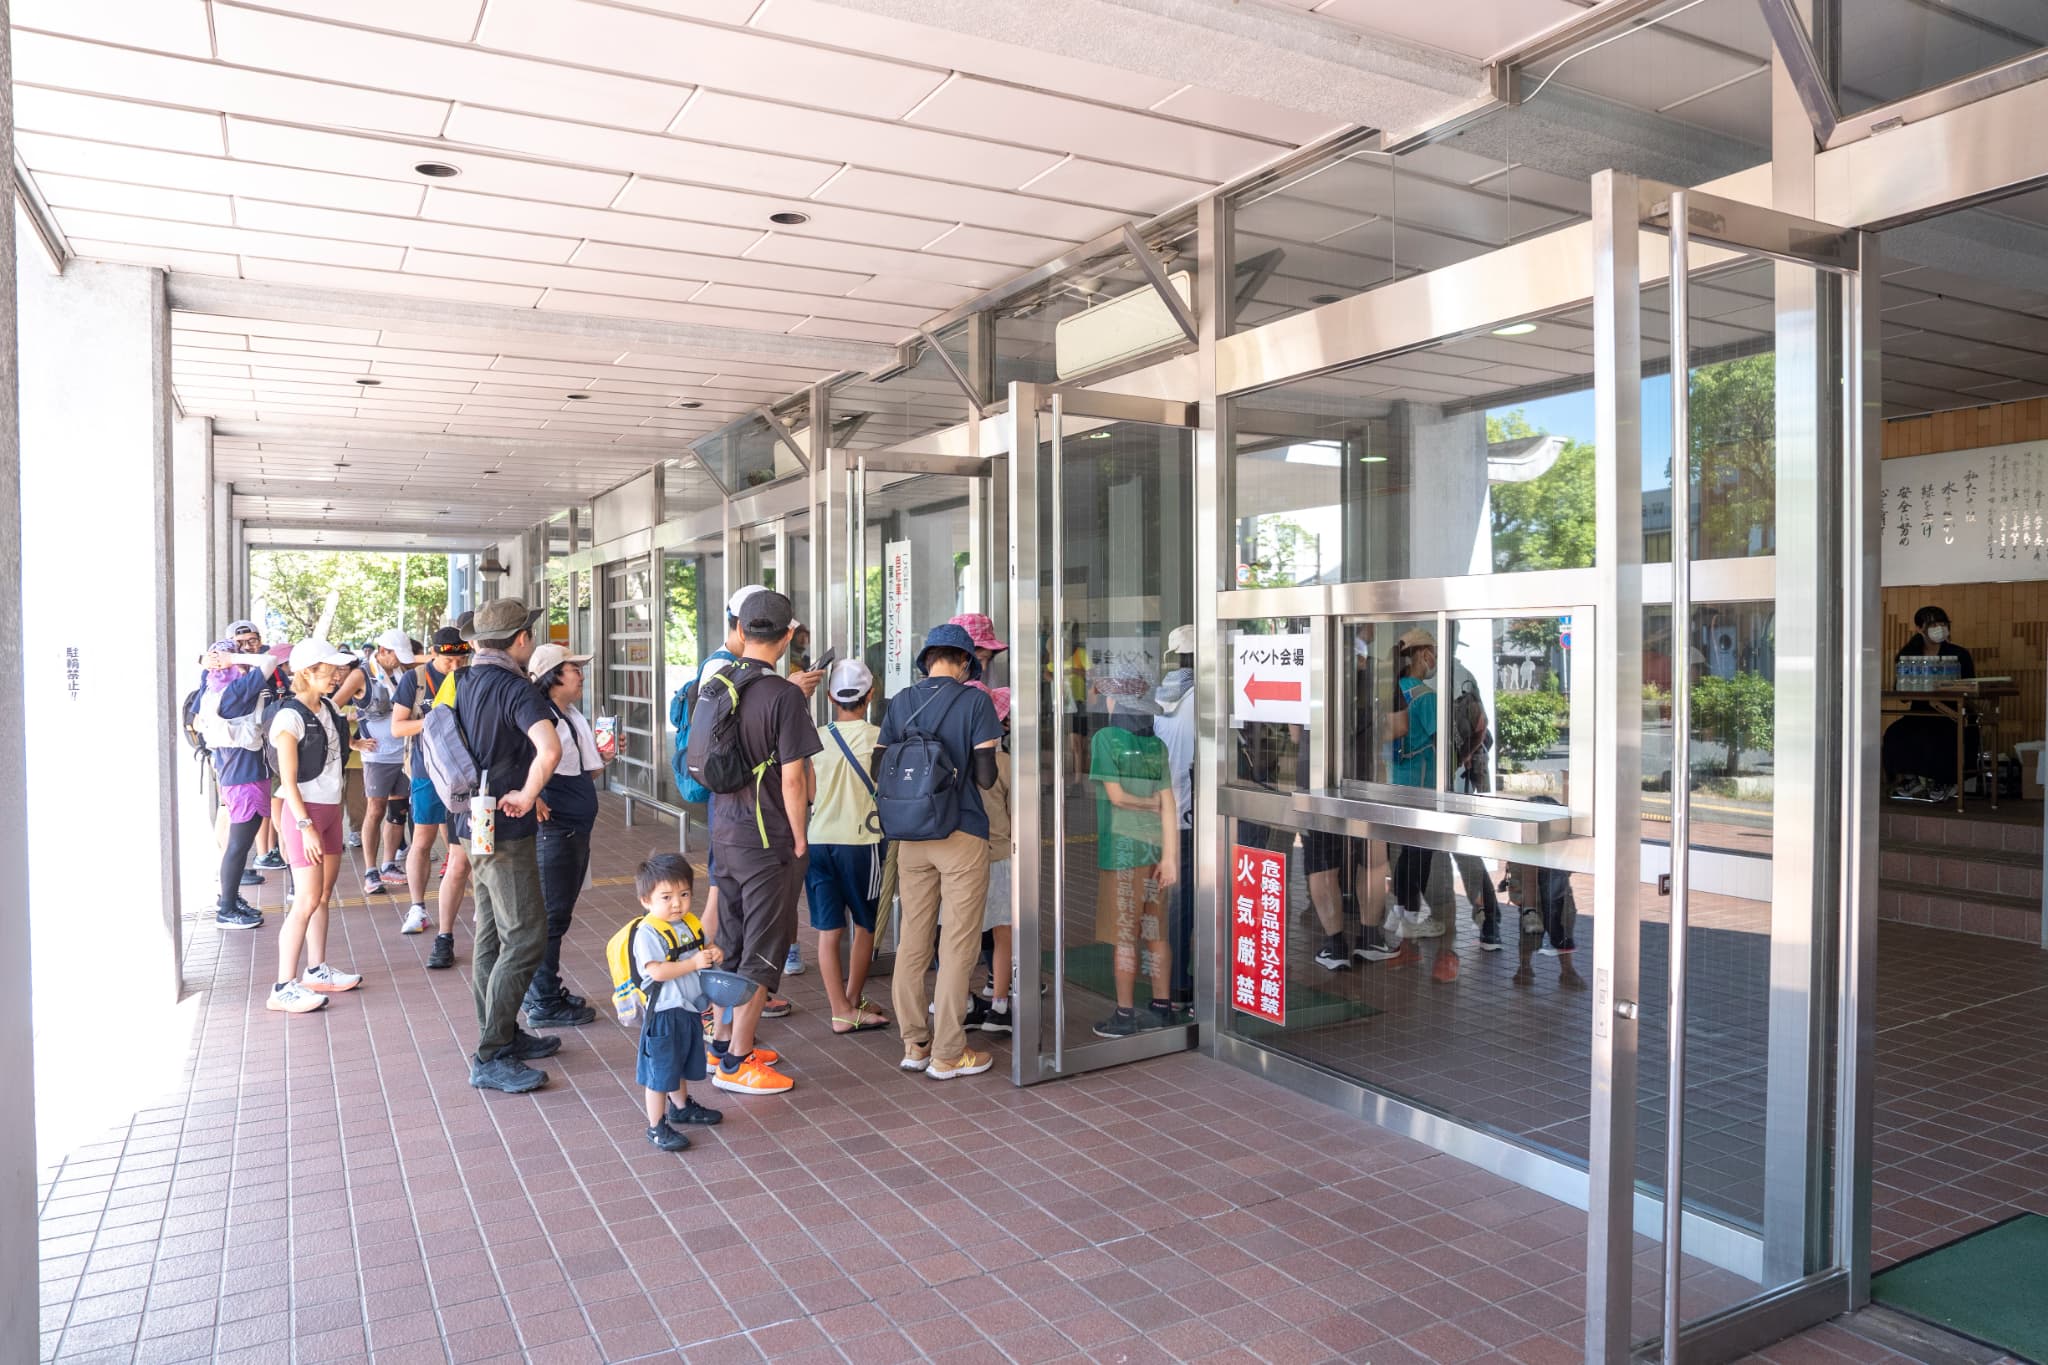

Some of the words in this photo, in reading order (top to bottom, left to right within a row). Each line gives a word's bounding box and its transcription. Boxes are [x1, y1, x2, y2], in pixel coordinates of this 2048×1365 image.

[1896, 486, 1912, 546] 安全に努め
[1240, 648, 1304, 666] イベント会場
[1237, 854, 1256, 1006] 火気厳禁
[1260, 859, 1281, 1017] 危険物品持込み厳禁
